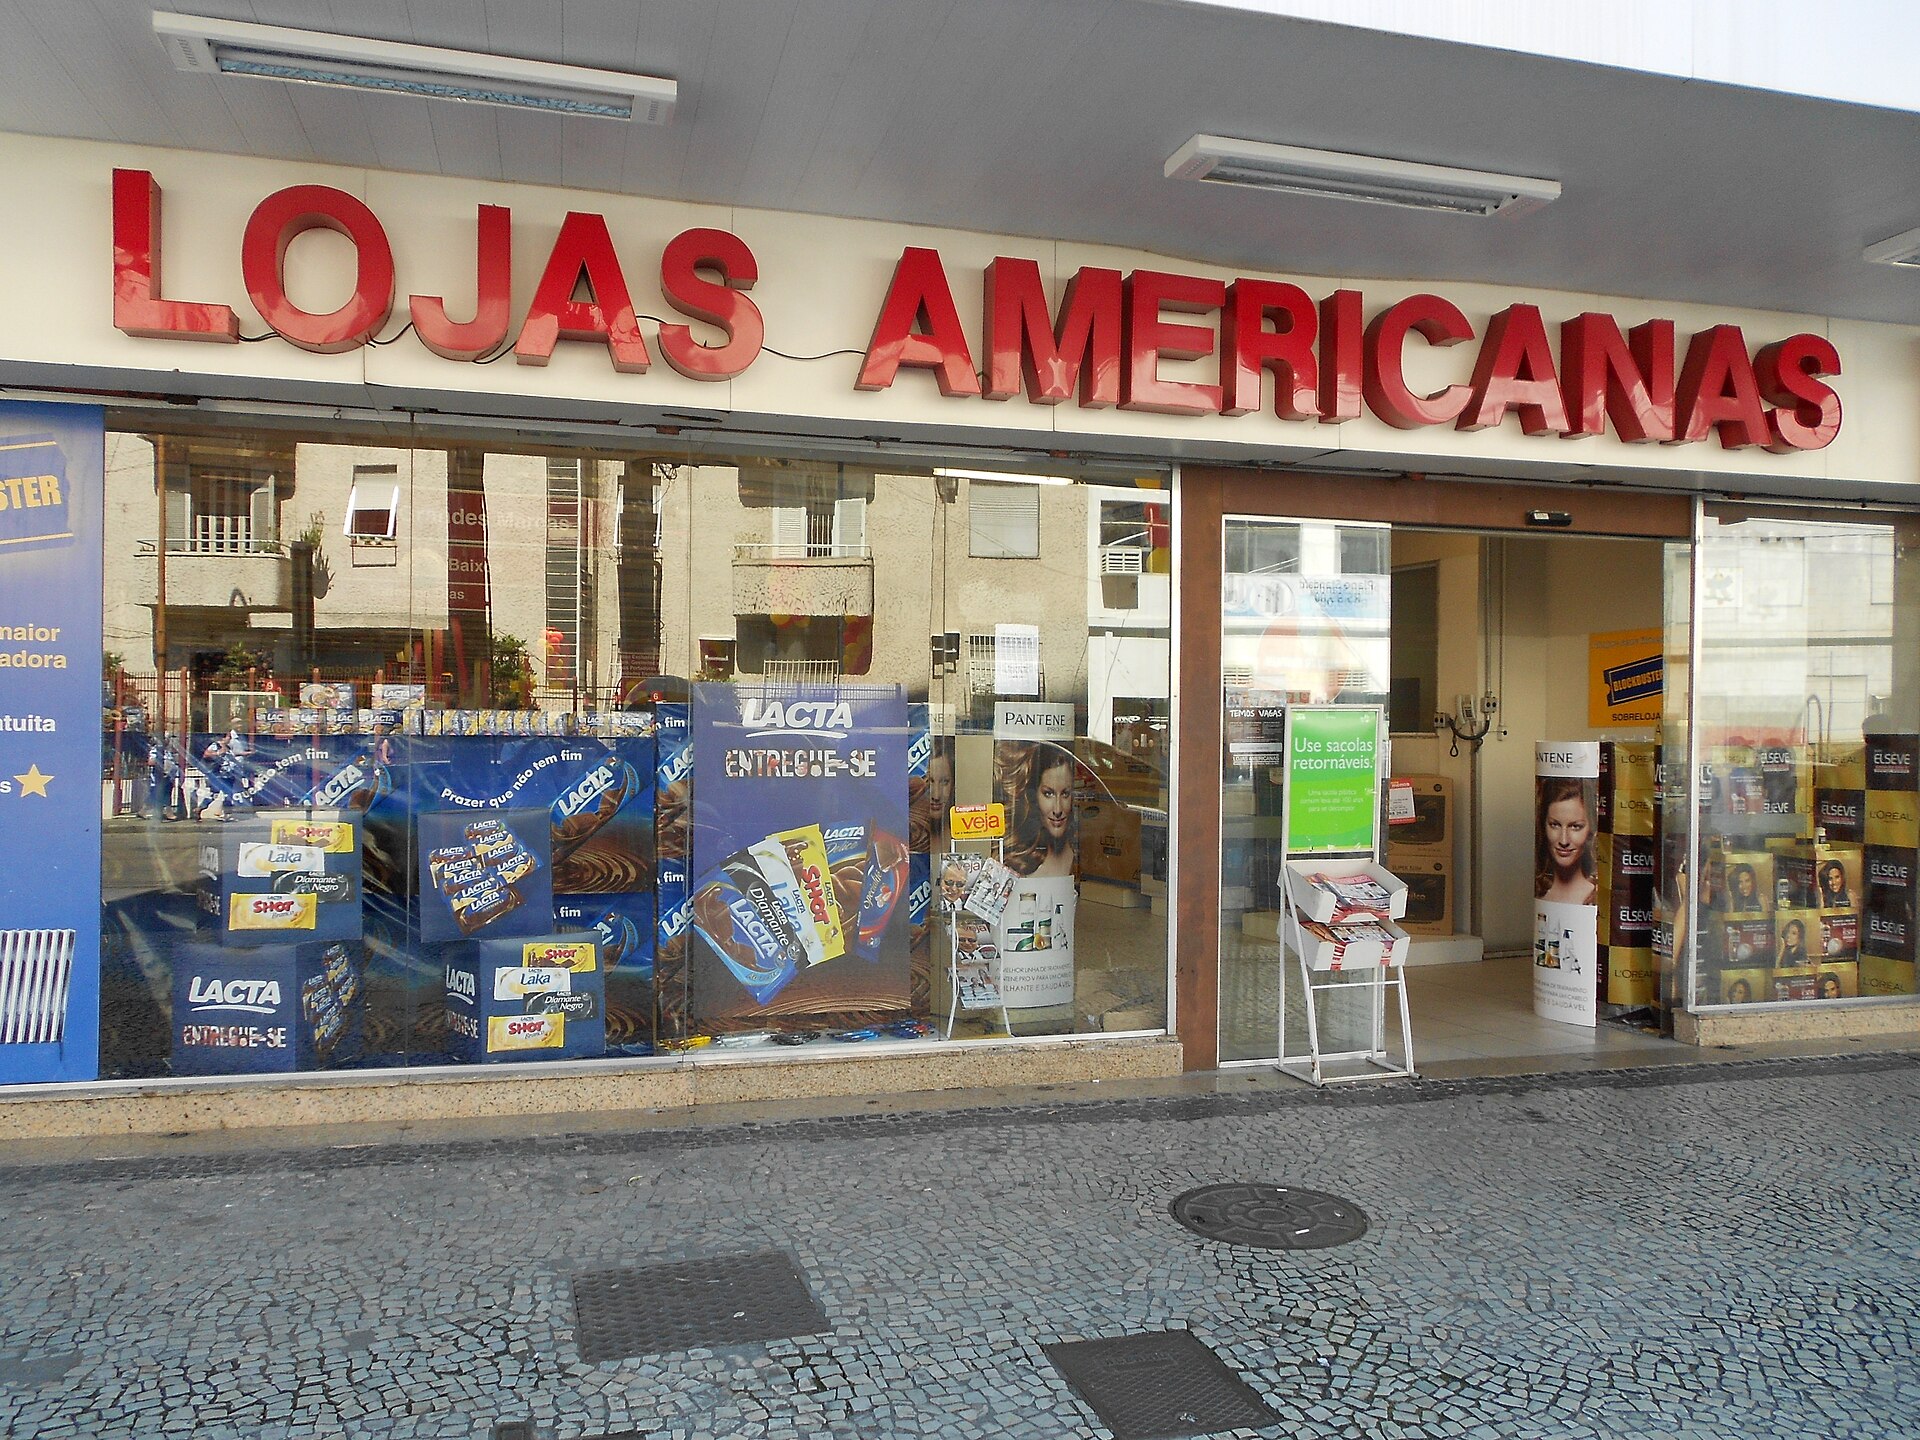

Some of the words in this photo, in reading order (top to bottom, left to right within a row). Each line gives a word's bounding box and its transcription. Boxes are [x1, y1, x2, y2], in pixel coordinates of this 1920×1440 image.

[113, 168, 763, 382] LOJAS
[856, 246, 1842, 451] AMERICANAS
[742, 698, 853, 729] LACTA
[1005, 711, 1066, 726] PANTENE
[1229, 709, 1255, 718] TEMOS
[1258, 709, 1283, 718] VAGAS
[1612, 712, 1661, 722] SOBRELOJA
[664, 716, 685, 728] fim
[1294, 737, 1322, 753] Use
[1326, 737, 1373, 752] sacolas
[305, 748, 329, 760] fim
[724, 749, 877, 778] ENTREGUE-SE
[1293, 754, 1373, 770] retornáveis.
[441, 788, 486, 808] Prazer
[489, 789, 514, 808] que
[512, 769, 534, 791] não
[533, 754, 558, 771] tem
[560, 750, 583, 761] fim
[558, 765, 613, 816] LACTA
[473, 819, 497, 830] LACTA
[961, 813, 1000, 832] veja
[480, 831, 504, 844] LACTA
[823, 826, 864, 839] LACTA
[268, 850, 302, 863] Laka
[439, 846, 464, 855] LACTA
[487, 843, 514, 858] LACTA
[444, 859, 473, 872] LACTA
[497, 854, 525, 872] LACTA
[955, 860, 981, 873] veja
[294, 875, 337, 884] Diamante
[453, 869, 481, 883] LACTA
[663, 871, 684, 883] fim
[311, 883, 339, 893] Negro
[461, 879, 492, 898] LACTA
[801, 864, 831, 925] SHOT
[824, 880, 835, 907] LACTA
[253, 901, 295, 913] SHOT
[470, 891, 500, 911] LACTA
[560, 906, 581, 918] fim
[750, 887, 790, 946] Diamante
[730, 898, 779, 958] LACTA
[545, 949, 577, 960] SHOT
[445, 964, 476, 997] LACTA
[520, 973, 551, 985] Laka
[189, 976, 281, 1005] LACTA
[544, 996, 582, 1004] Diamante
[559, 1003, 584, 1012] Negro
[508, 1021, 545, 1035] SHOT
[183, 1025, 287, 1048] ENTREGUE-SE
